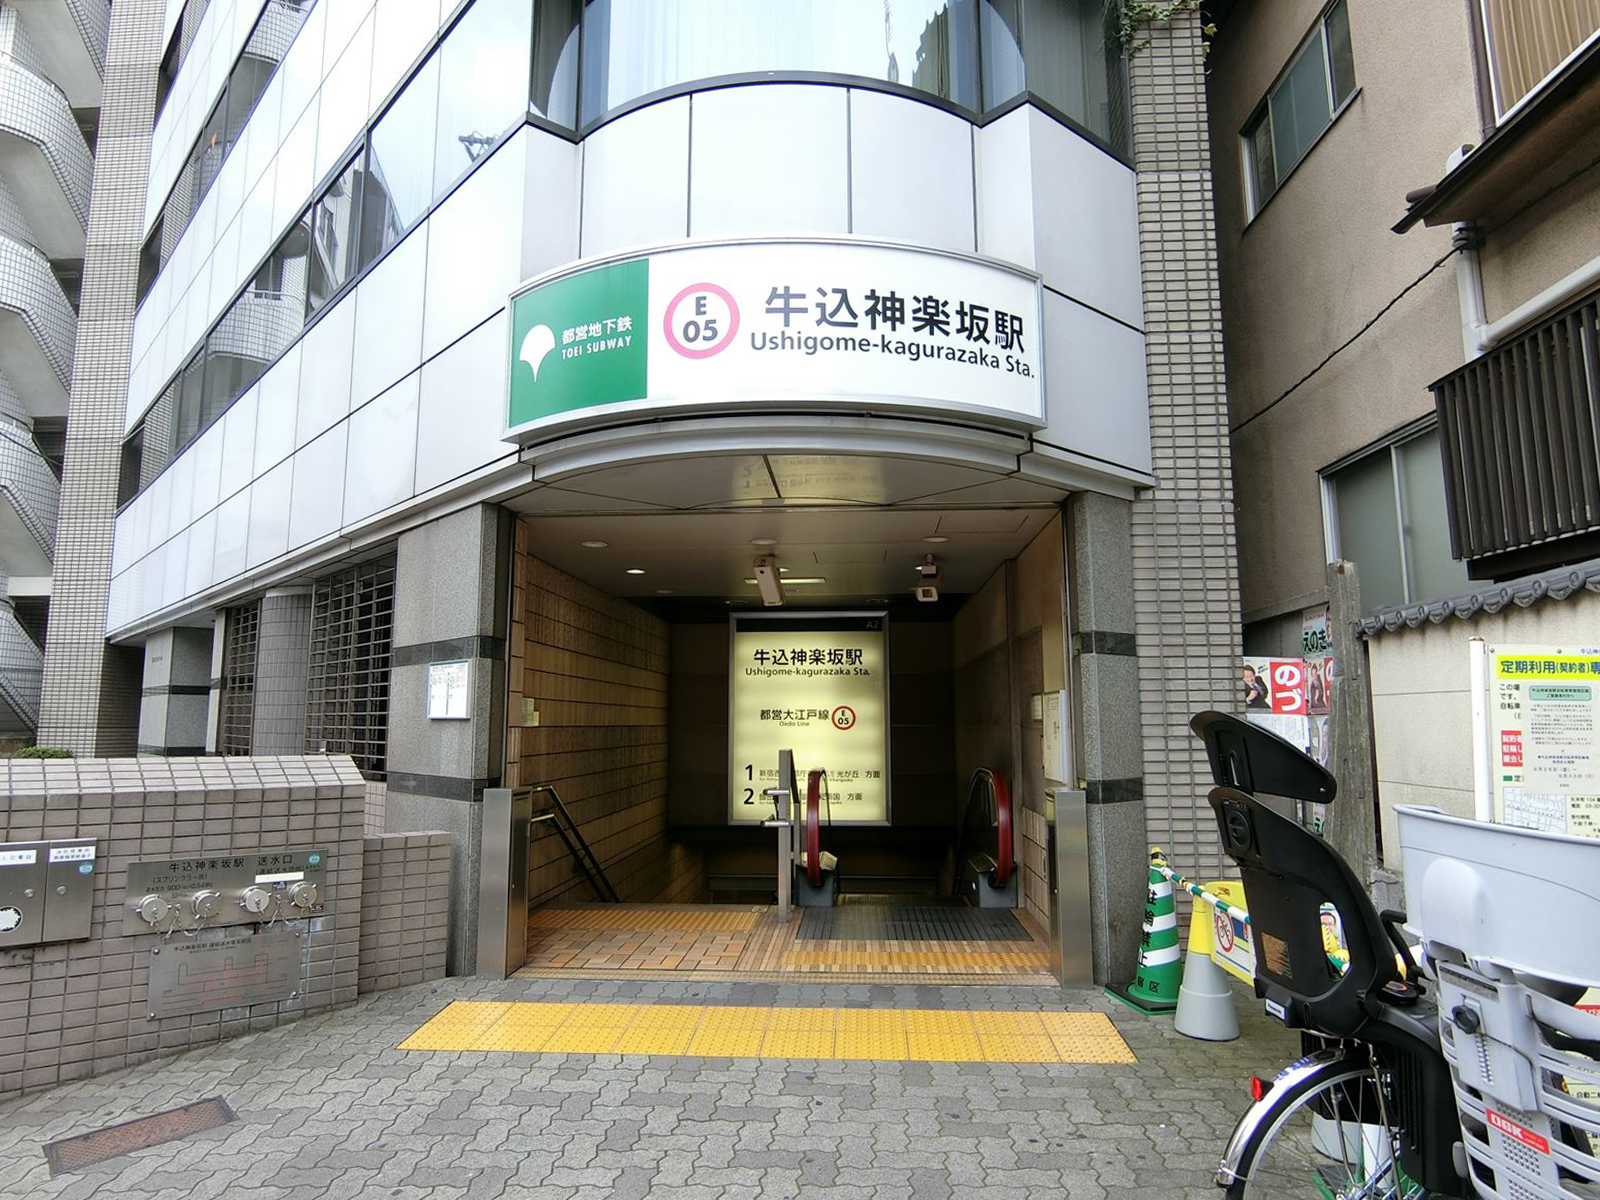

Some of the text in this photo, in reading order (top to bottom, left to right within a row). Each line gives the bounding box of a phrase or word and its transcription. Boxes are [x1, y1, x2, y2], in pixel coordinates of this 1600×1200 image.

[695, 296, 707, 317] E
[765, 286, 1025, 353] 牛込神楽坂駅
[562, 315, 632, 345] 都営地下鉄
[683, 320, 718, 343] 05
[562, 335, 632, 360] TOEI SUBWAY
[751, 330, 1035, 379] Ushigome-kagurazaka Sta.
[866, 620, 879, 629] A2
[754, 649, 862, 665] 牛込神楽坂駅
[745, 667, 870, 678] Ushigome-kagurazaka Sta.
[1275, 664, 1301, 711] のづ
[760, 709, 829, 720] 都営大江戸線
[837, 717, 849, 725] 05
[745, 764, 753, 781] 1
[865, 770, 881, 778] 方面
[743, 788, 754, 805] 2
[169, 855, 293, 873] 牛込神楽坂駅 送水口
